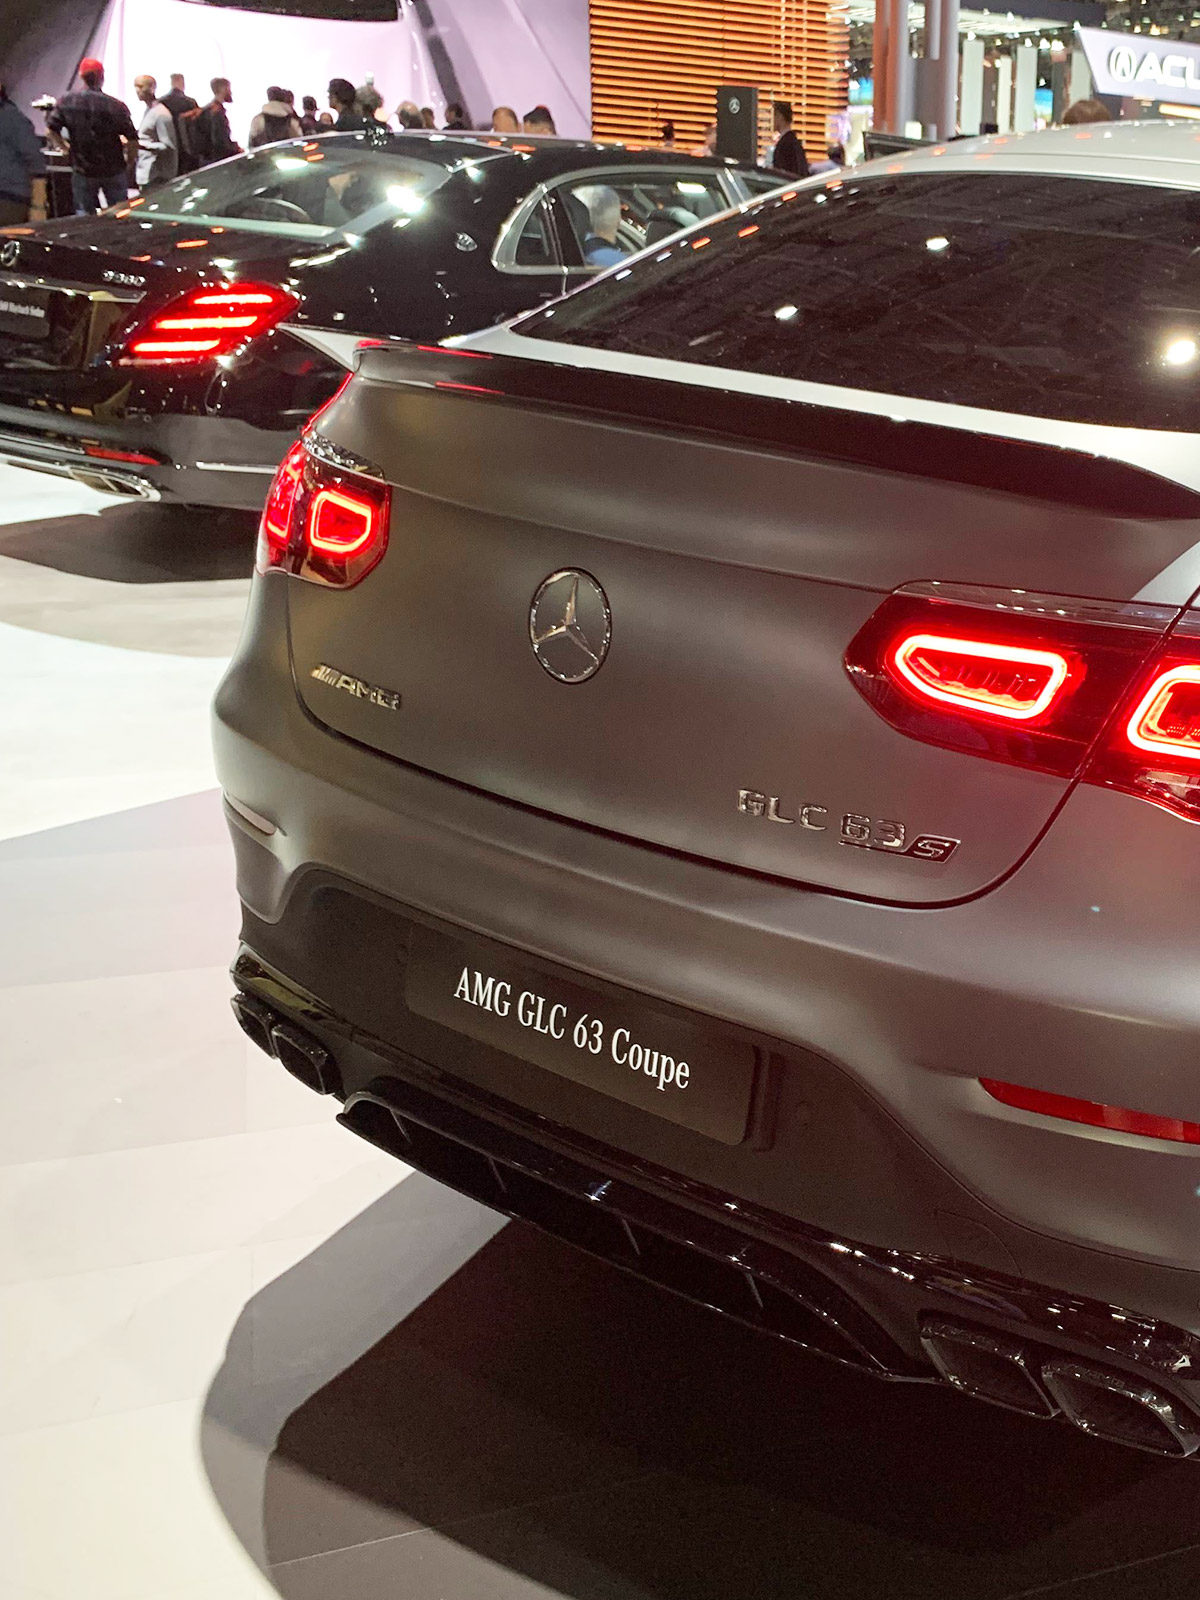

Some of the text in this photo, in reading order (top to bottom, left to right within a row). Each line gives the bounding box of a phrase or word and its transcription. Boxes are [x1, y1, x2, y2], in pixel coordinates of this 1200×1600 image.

[334, 672, 400, 710] AMG
[738, 789, 950, 858] GLC 63 S
[453, 966, 690, 1091] AMG GLC 63 Coupe
